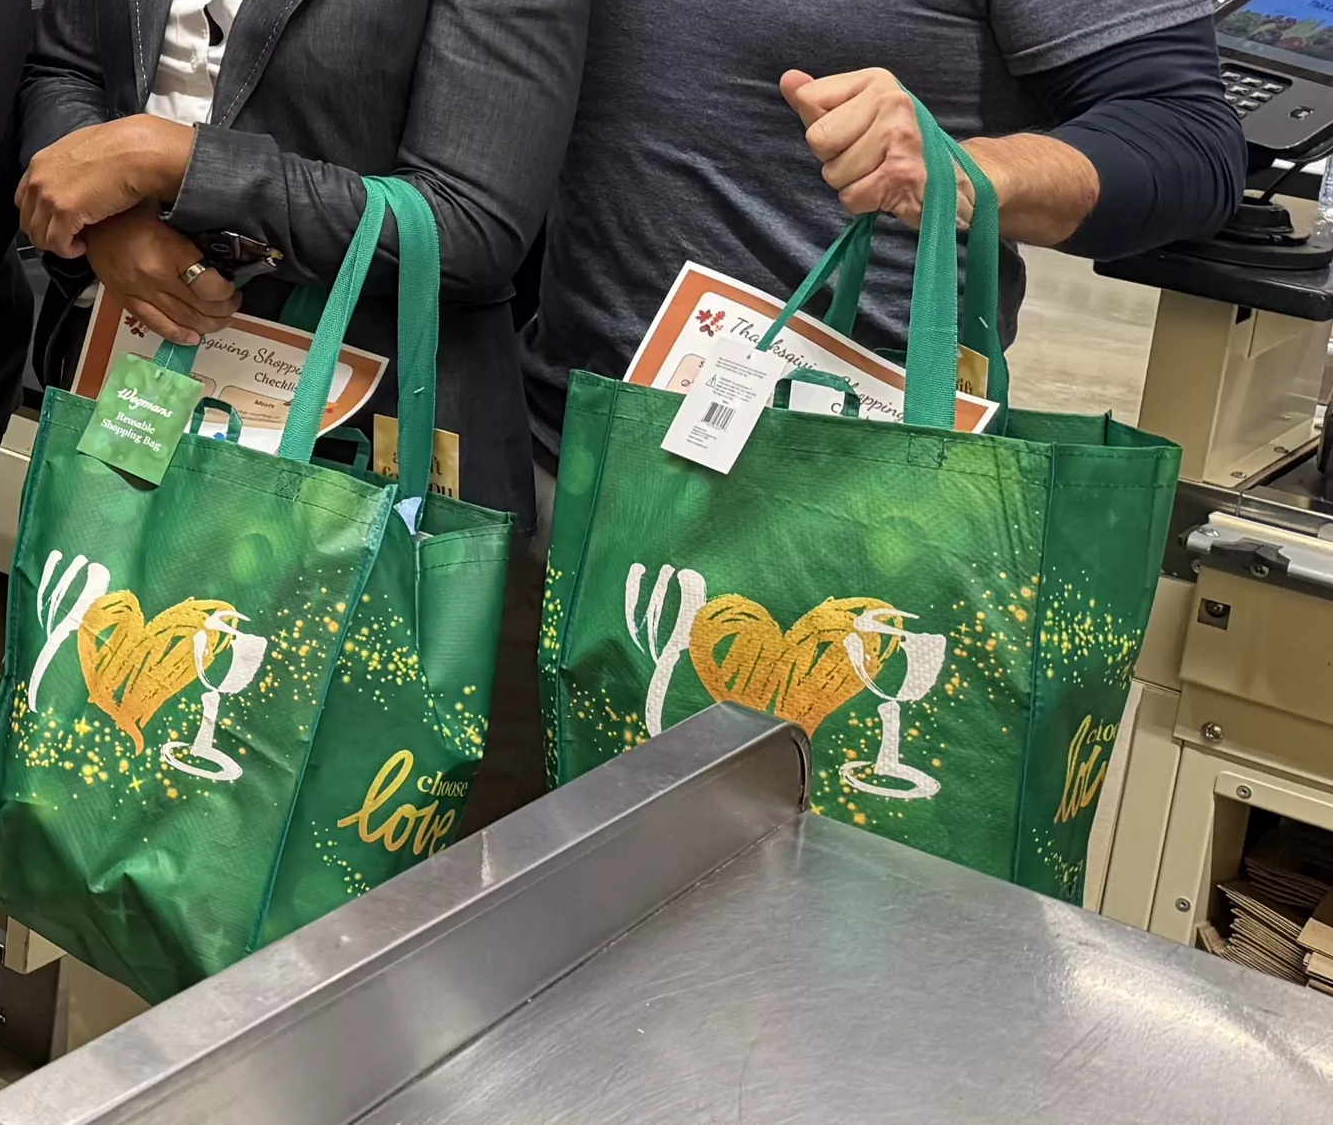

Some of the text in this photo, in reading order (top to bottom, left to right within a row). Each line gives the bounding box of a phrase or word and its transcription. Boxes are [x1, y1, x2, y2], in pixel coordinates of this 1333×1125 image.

[199, 337, 305, 376] sgiving Shoppi
[730, 317, 819, 372] Thaksgivi
[254, 372, 299, 392] Checkli
[117, 388, 173, 419] Wegmans
[100, 418, 163, 452] Shopping Bag
[116, 411, 156, 434] Reusable
[417, 771, 468, 797] choose
[1054, 714, 1108, 824] lov
[337, 749, 455, 858] love
